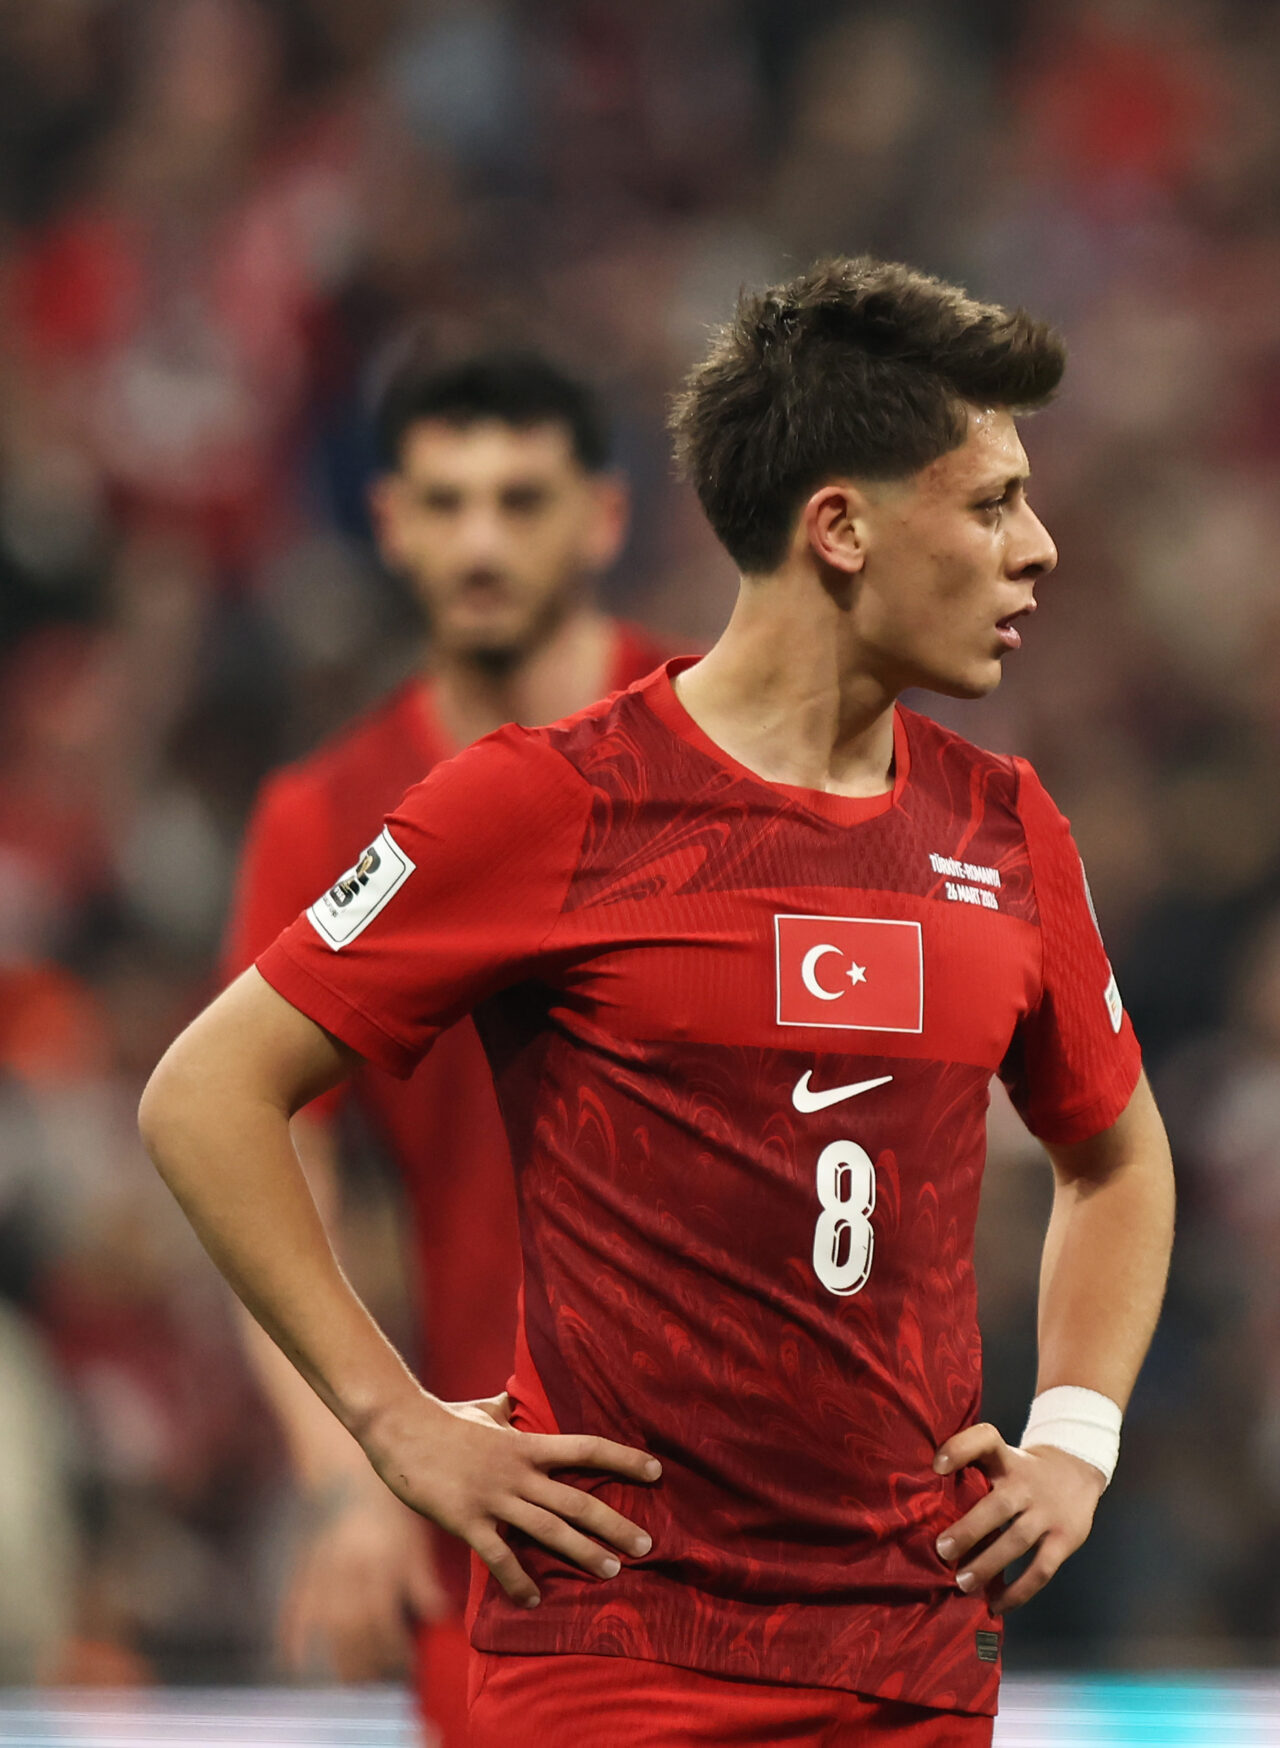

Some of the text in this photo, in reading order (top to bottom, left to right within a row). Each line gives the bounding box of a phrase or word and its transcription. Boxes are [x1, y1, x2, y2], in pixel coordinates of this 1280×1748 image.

[945, 881, 958, 900] 26
[956, 884, 981, 905] MART
[813, 1139, 876, 1296] 8
